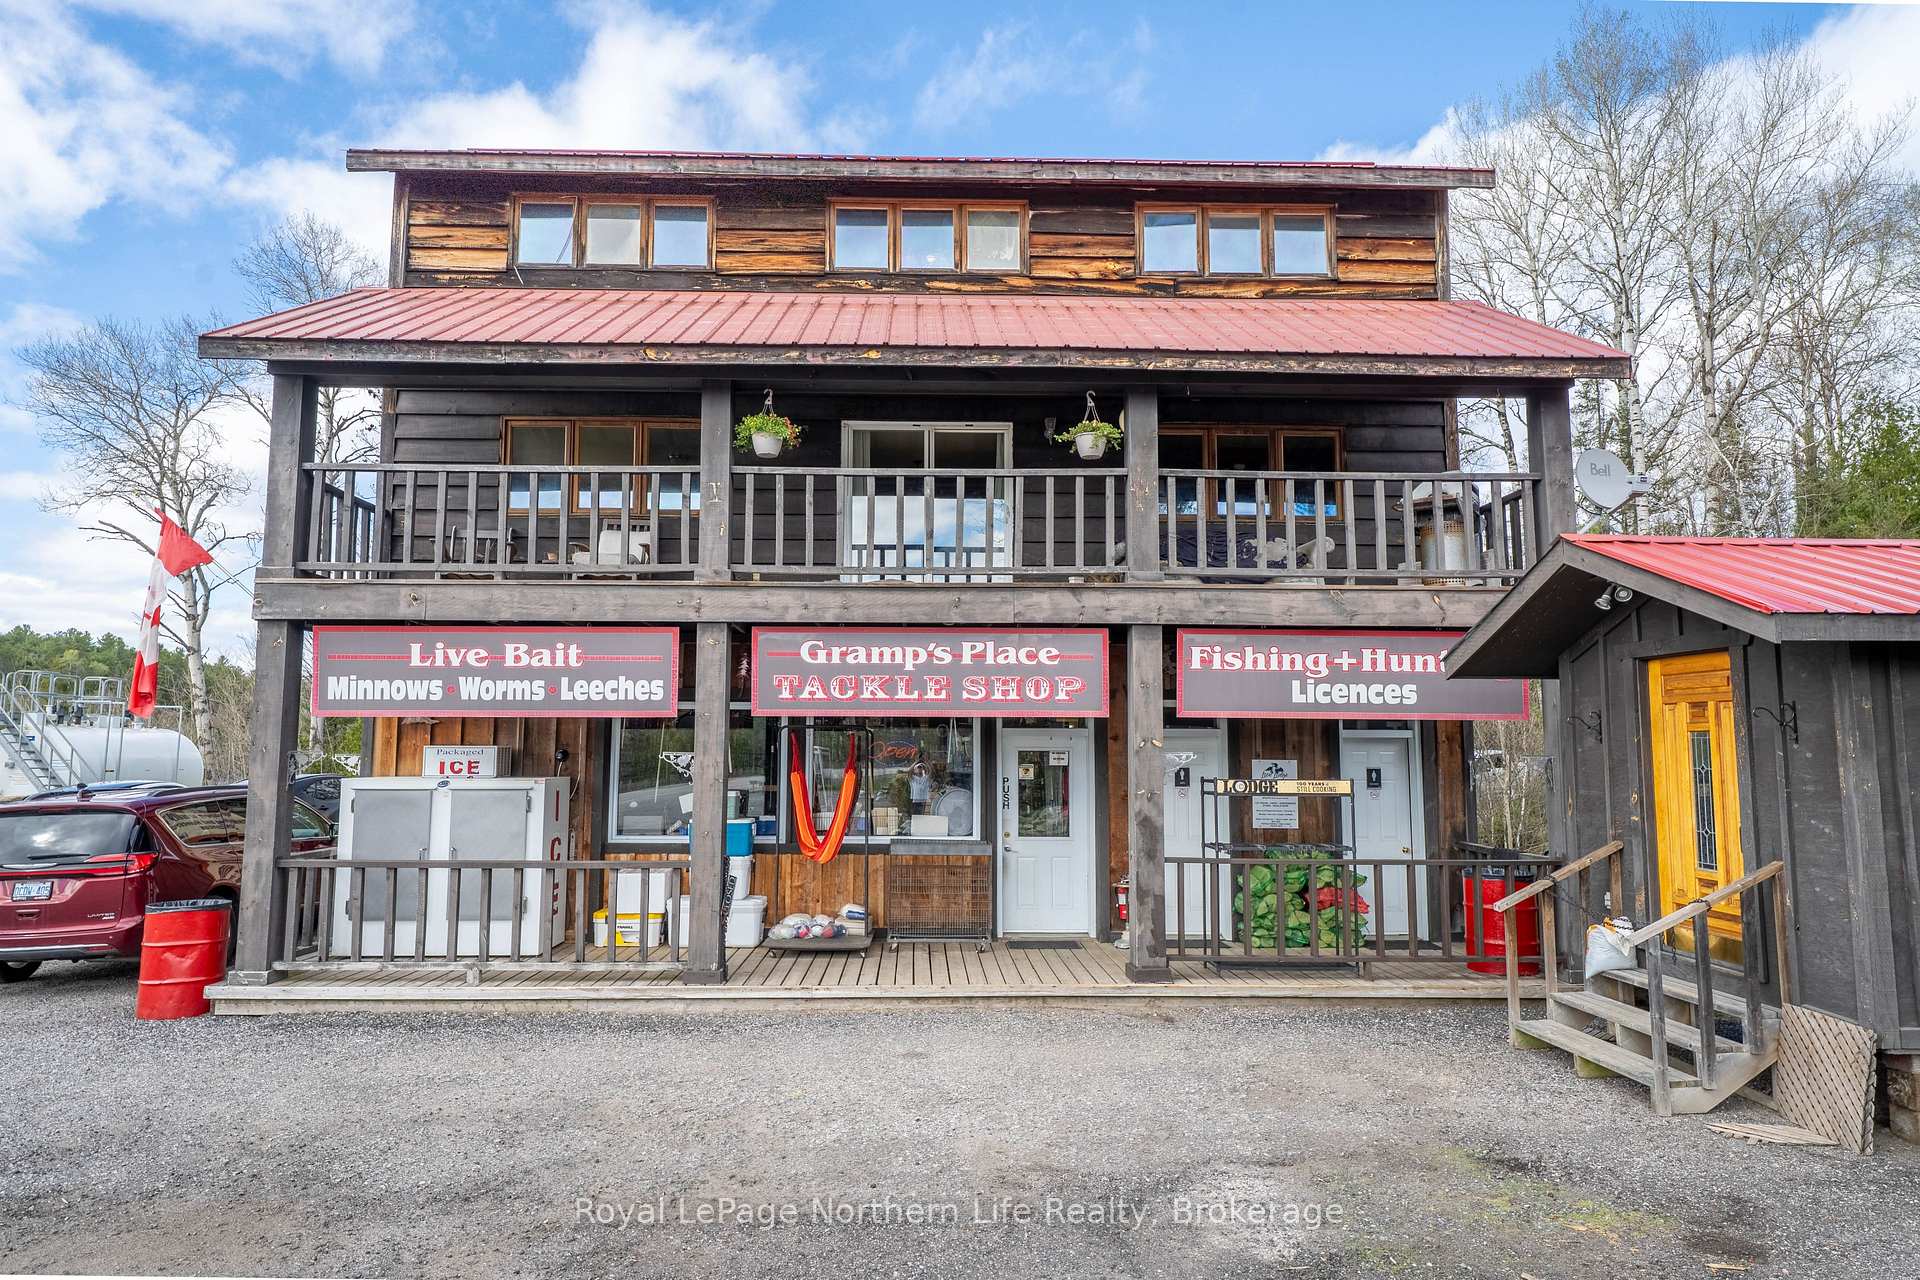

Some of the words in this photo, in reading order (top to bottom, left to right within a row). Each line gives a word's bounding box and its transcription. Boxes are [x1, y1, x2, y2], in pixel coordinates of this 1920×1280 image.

[1590, 462, 1610, 477] Bell
[408, 642, 489, 667] Live
[503, 642, 584, 667] Bait
[799, 641, 953, 671] Gramp's
[960, 641, 1061, 665] Place
[327, 675, 443, 701] Minnows
[458, 676, 545, 701] Worms
[560, 675, 664, 701] Leeches
[773, 674, 952, 702] TACKLE
[962, 674, 1087, 703] SHOP
[1291, 678, 1418, 705] Licences
[436, 748, 484, 757] Packaged
[438, 760, 481, 775] ICE
[1002, 776, 1010, 809] PUSH
[1223, 780, 1278, 794] LODGE
